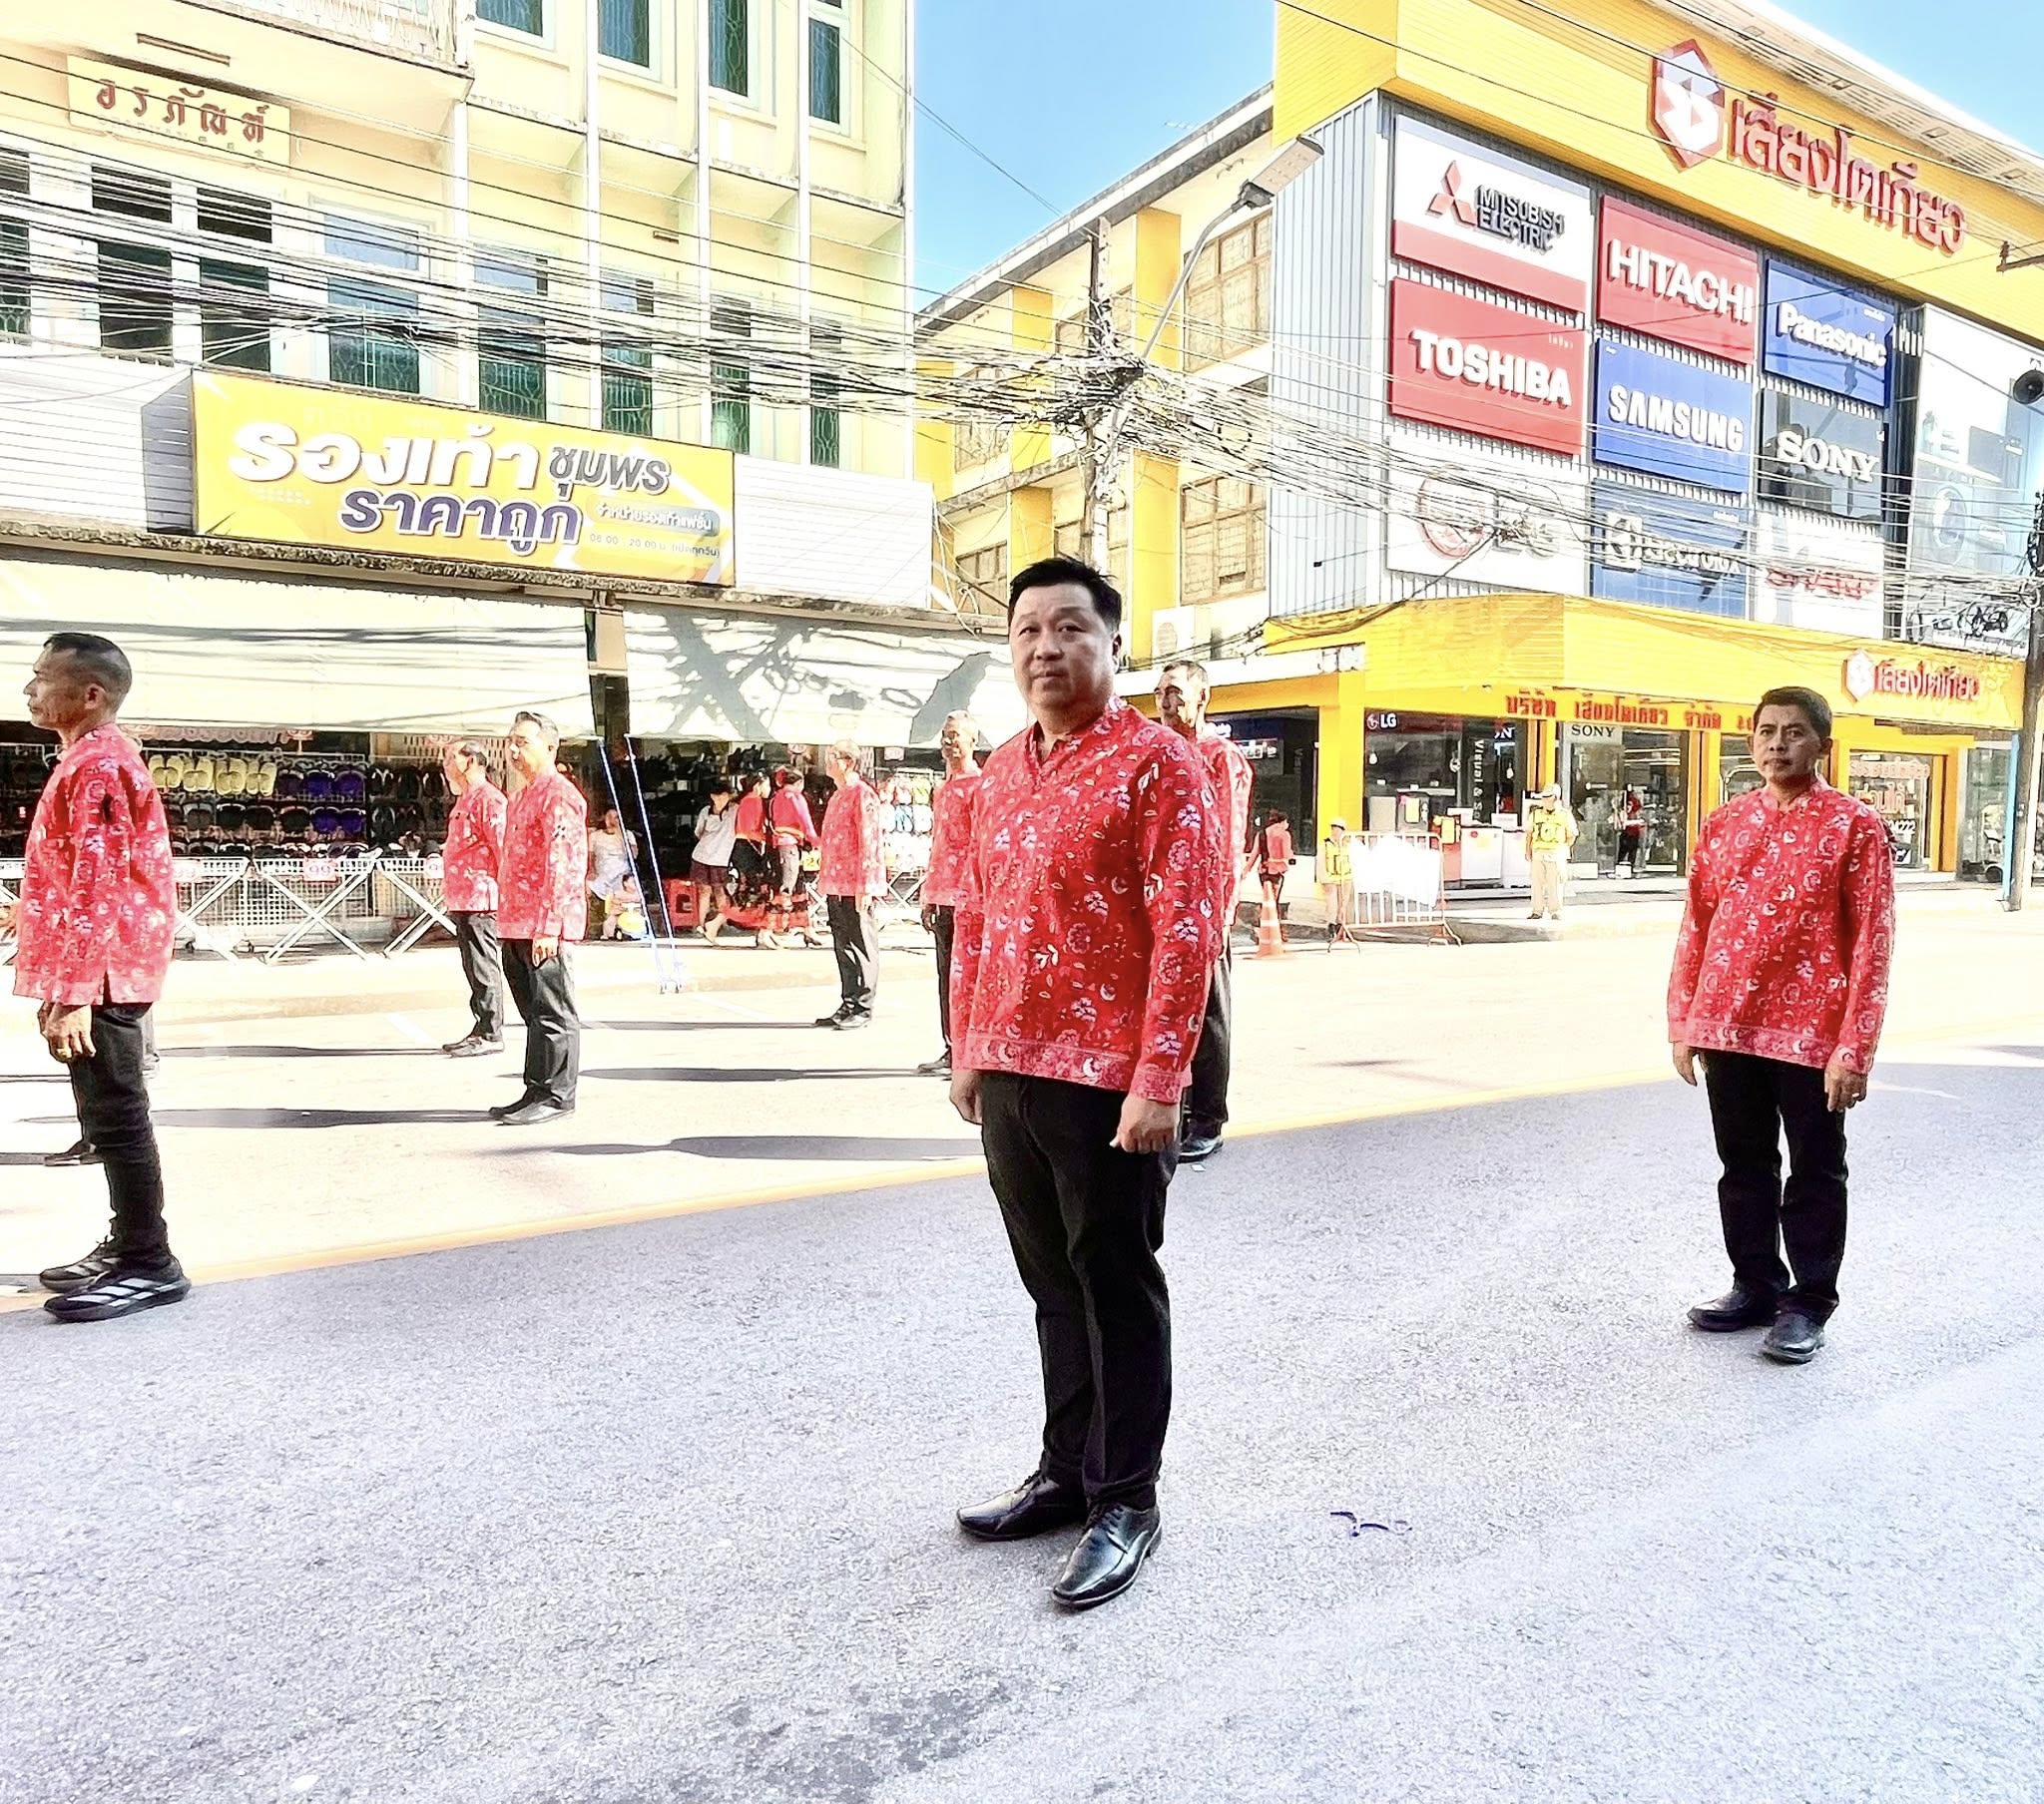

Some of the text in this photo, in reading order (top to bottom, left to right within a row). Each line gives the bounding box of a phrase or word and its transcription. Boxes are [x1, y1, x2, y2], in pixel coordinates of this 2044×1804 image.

[1607, 238, 1754, 325] HITACHI
[1776, 301, 1887, 368] Panasonic
[1408, 328, 1573, 409] TOSHIBA
[1609, 384, 1745, 451] SAMSUNG
[228, 419, 672, 501] รองเท้า ชุมพร
[1777, 429, 1879, 483] SONY
[338, 486, 583, 557] ราคาถูก
[1379, 712, 1397, 728] LG
[1571, 724, 1615, 737] SONY
